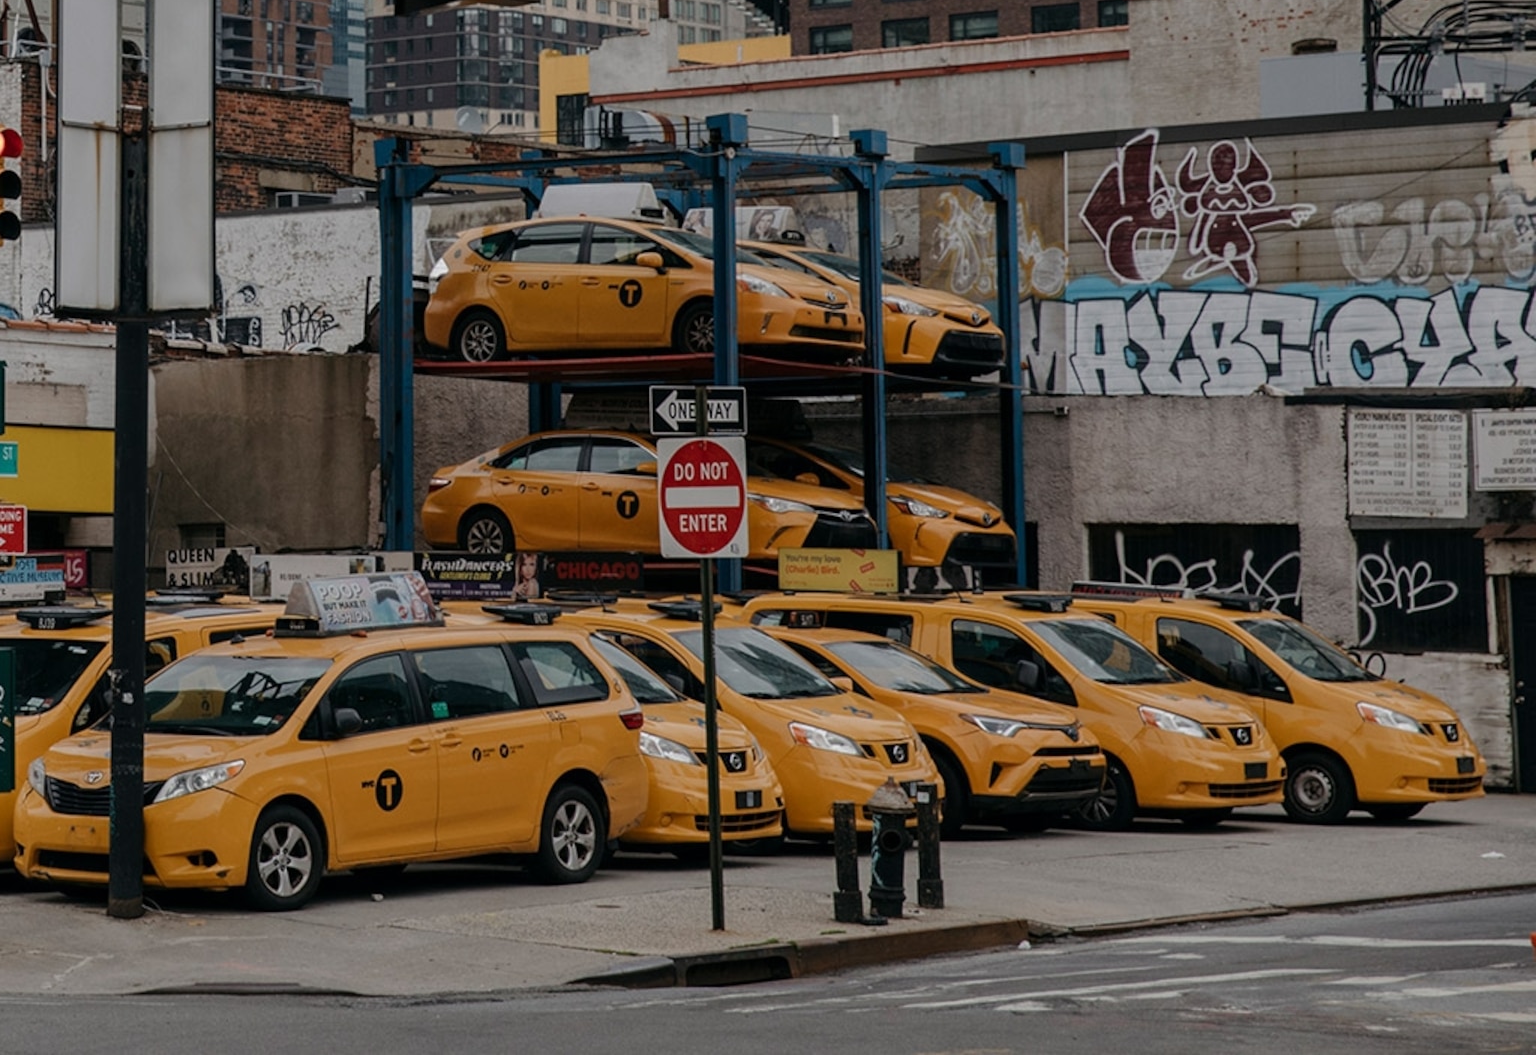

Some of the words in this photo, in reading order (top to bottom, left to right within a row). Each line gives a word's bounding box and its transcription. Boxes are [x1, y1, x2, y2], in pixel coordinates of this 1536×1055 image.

[668, 402, 696, 420] ONE
[2, 446, 13, 461] ST
[674, 463, 695, 481] DO
[699, 462, 729, 481] NOT
[679, 514, 728, 533] ENTER
[168, 548, 215, 564] QUEEN
[785, 554, 809, 564] You're
[811, 556, 822, 564] my
[825, 555, 841, 563] love
[27, 570, 62, 583] MUSEUM
[555, 561, 640, 580] CHICAGO
[785, 565, 819, 575] (Charlie)
[169, 572, 177, 587] &
[181, 571, 214, 587] SLIM
[319, 582, 363, 600] POOP
[323, 602, 338, 611] BUT
[339, 601, 359, 610] MAKE
[360, 600, 367, 609] IT
[327, 610, 372, 625] FASHION
